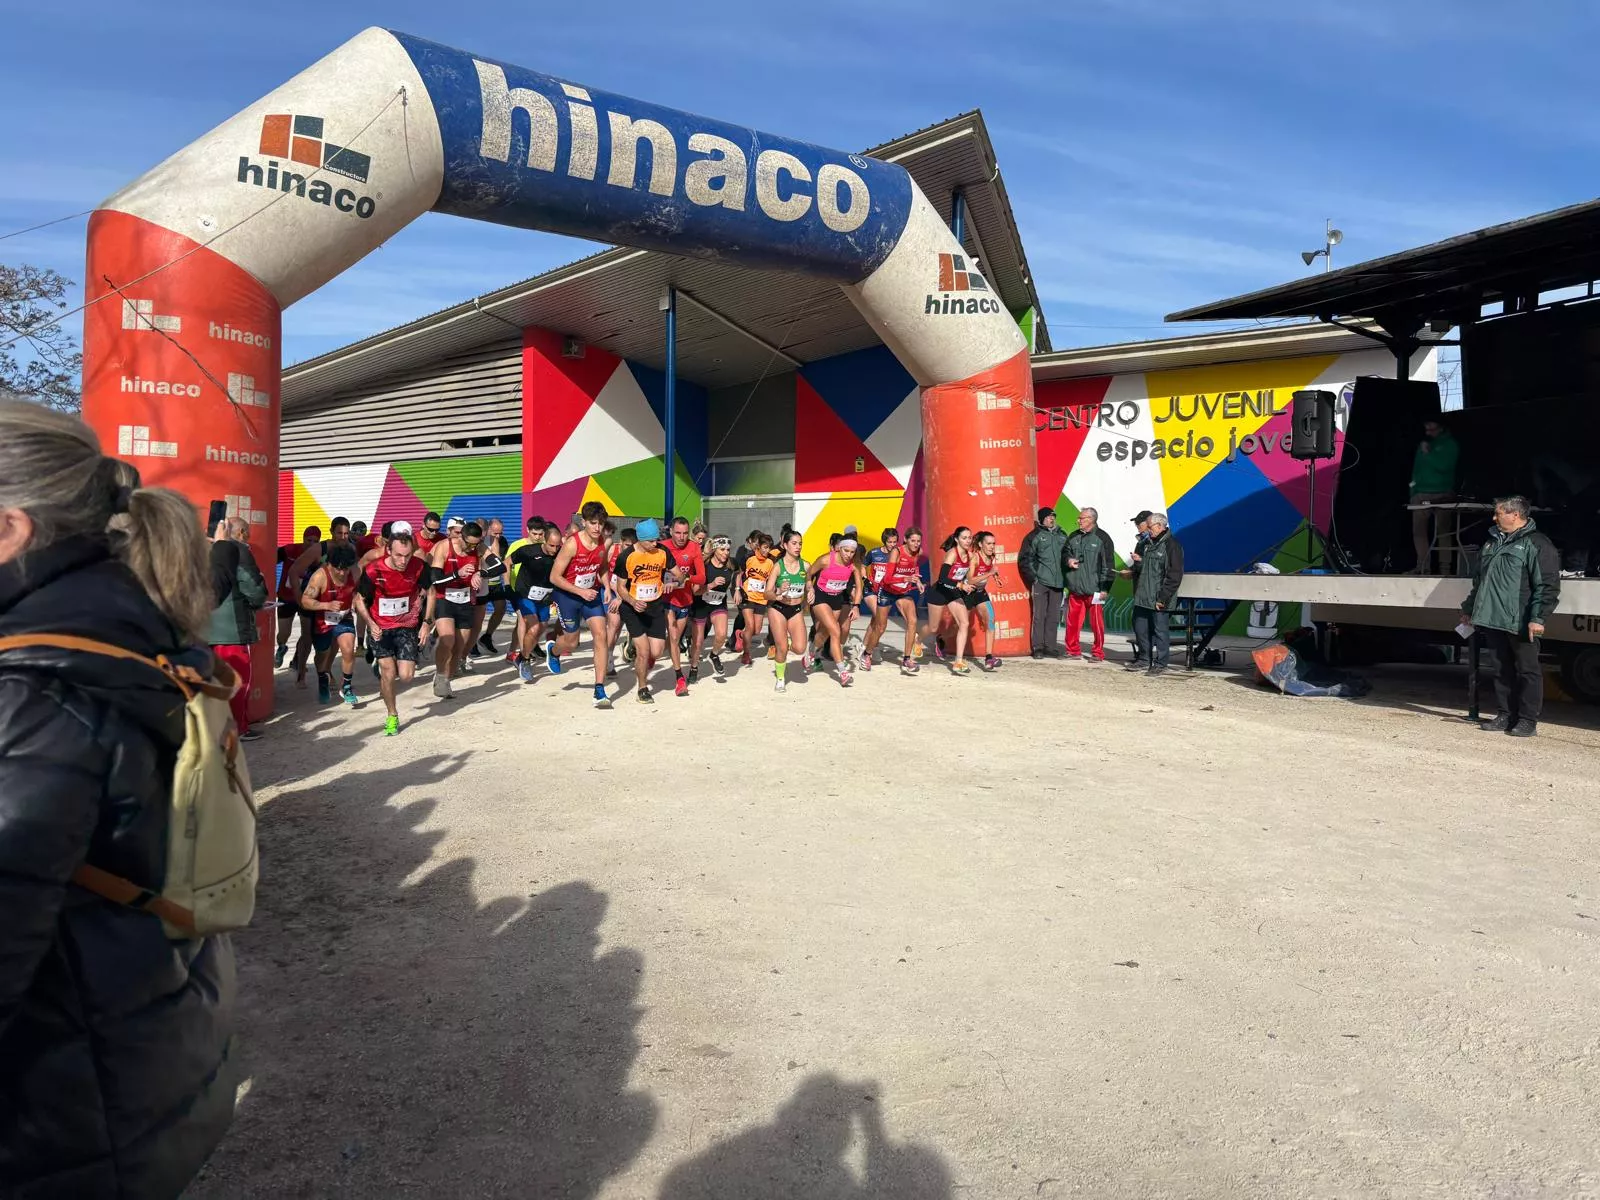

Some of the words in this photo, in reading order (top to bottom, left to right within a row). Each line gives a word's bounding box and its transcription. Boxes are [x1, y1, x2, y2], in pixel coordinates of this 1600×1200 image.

[472, 59, 870, 233] hinaco
[324, 164, 366, 182] Constructora
[237, 156, 376, 219] hinaco
[924, 293, 1000, 315] hinaco
[208, 321, 272, 349] hinaco
[121, 376, 201, 398] hinaco
[1154, 389, 1287, 424] JUVENIL
[980, 438, 1022, 449] hinaco
[1096, 429, 1215, 467] espacio
[205, 445, 268, 466] hinaco
[984, 515, 1026, 526] hinaco
[989, 591, 1030, 602] hinaco
